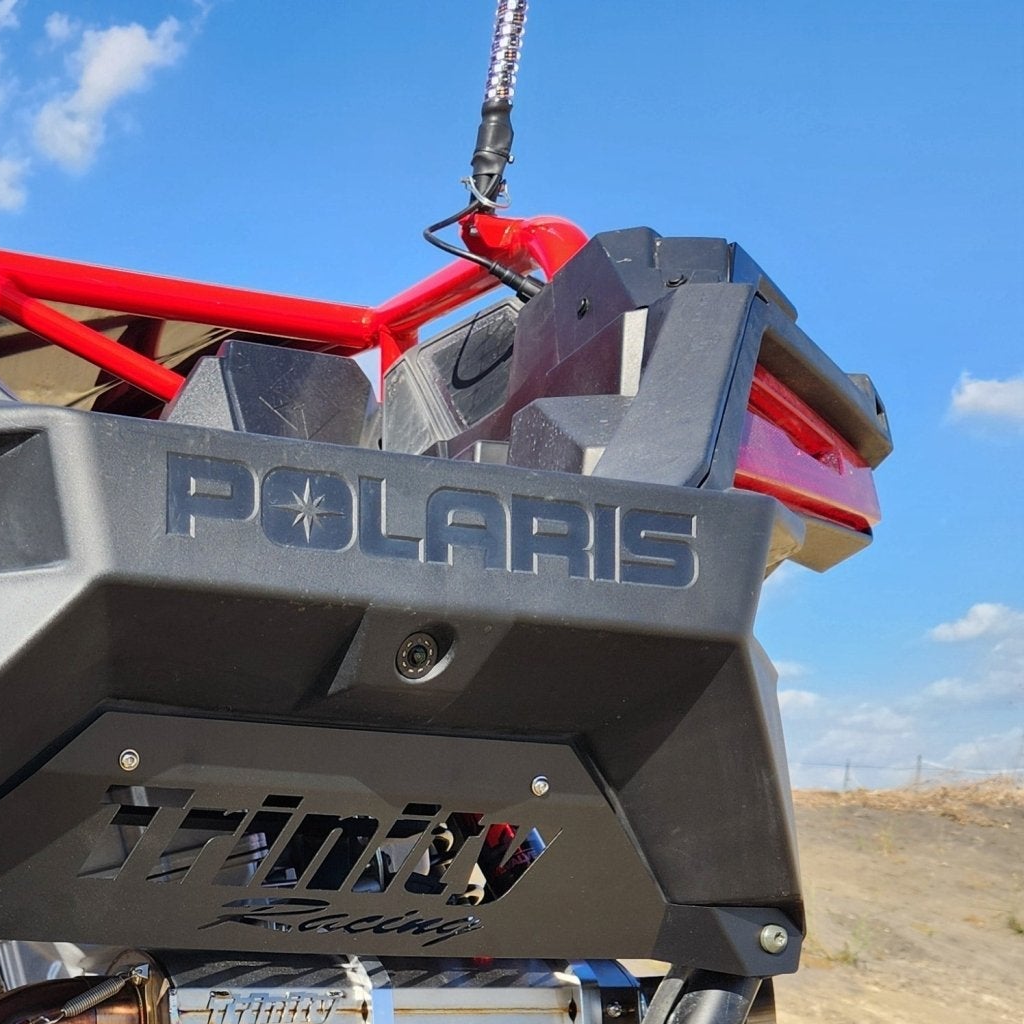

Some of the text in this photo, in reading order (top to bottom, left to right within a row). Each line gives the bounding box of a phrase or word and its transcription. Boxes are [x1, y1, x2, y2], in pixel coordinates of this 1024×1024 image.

[165, 451, 700, 589] POLARIS
[77, 784, 563, 907] Trinity
[197, 897, 485, 947] Racing
